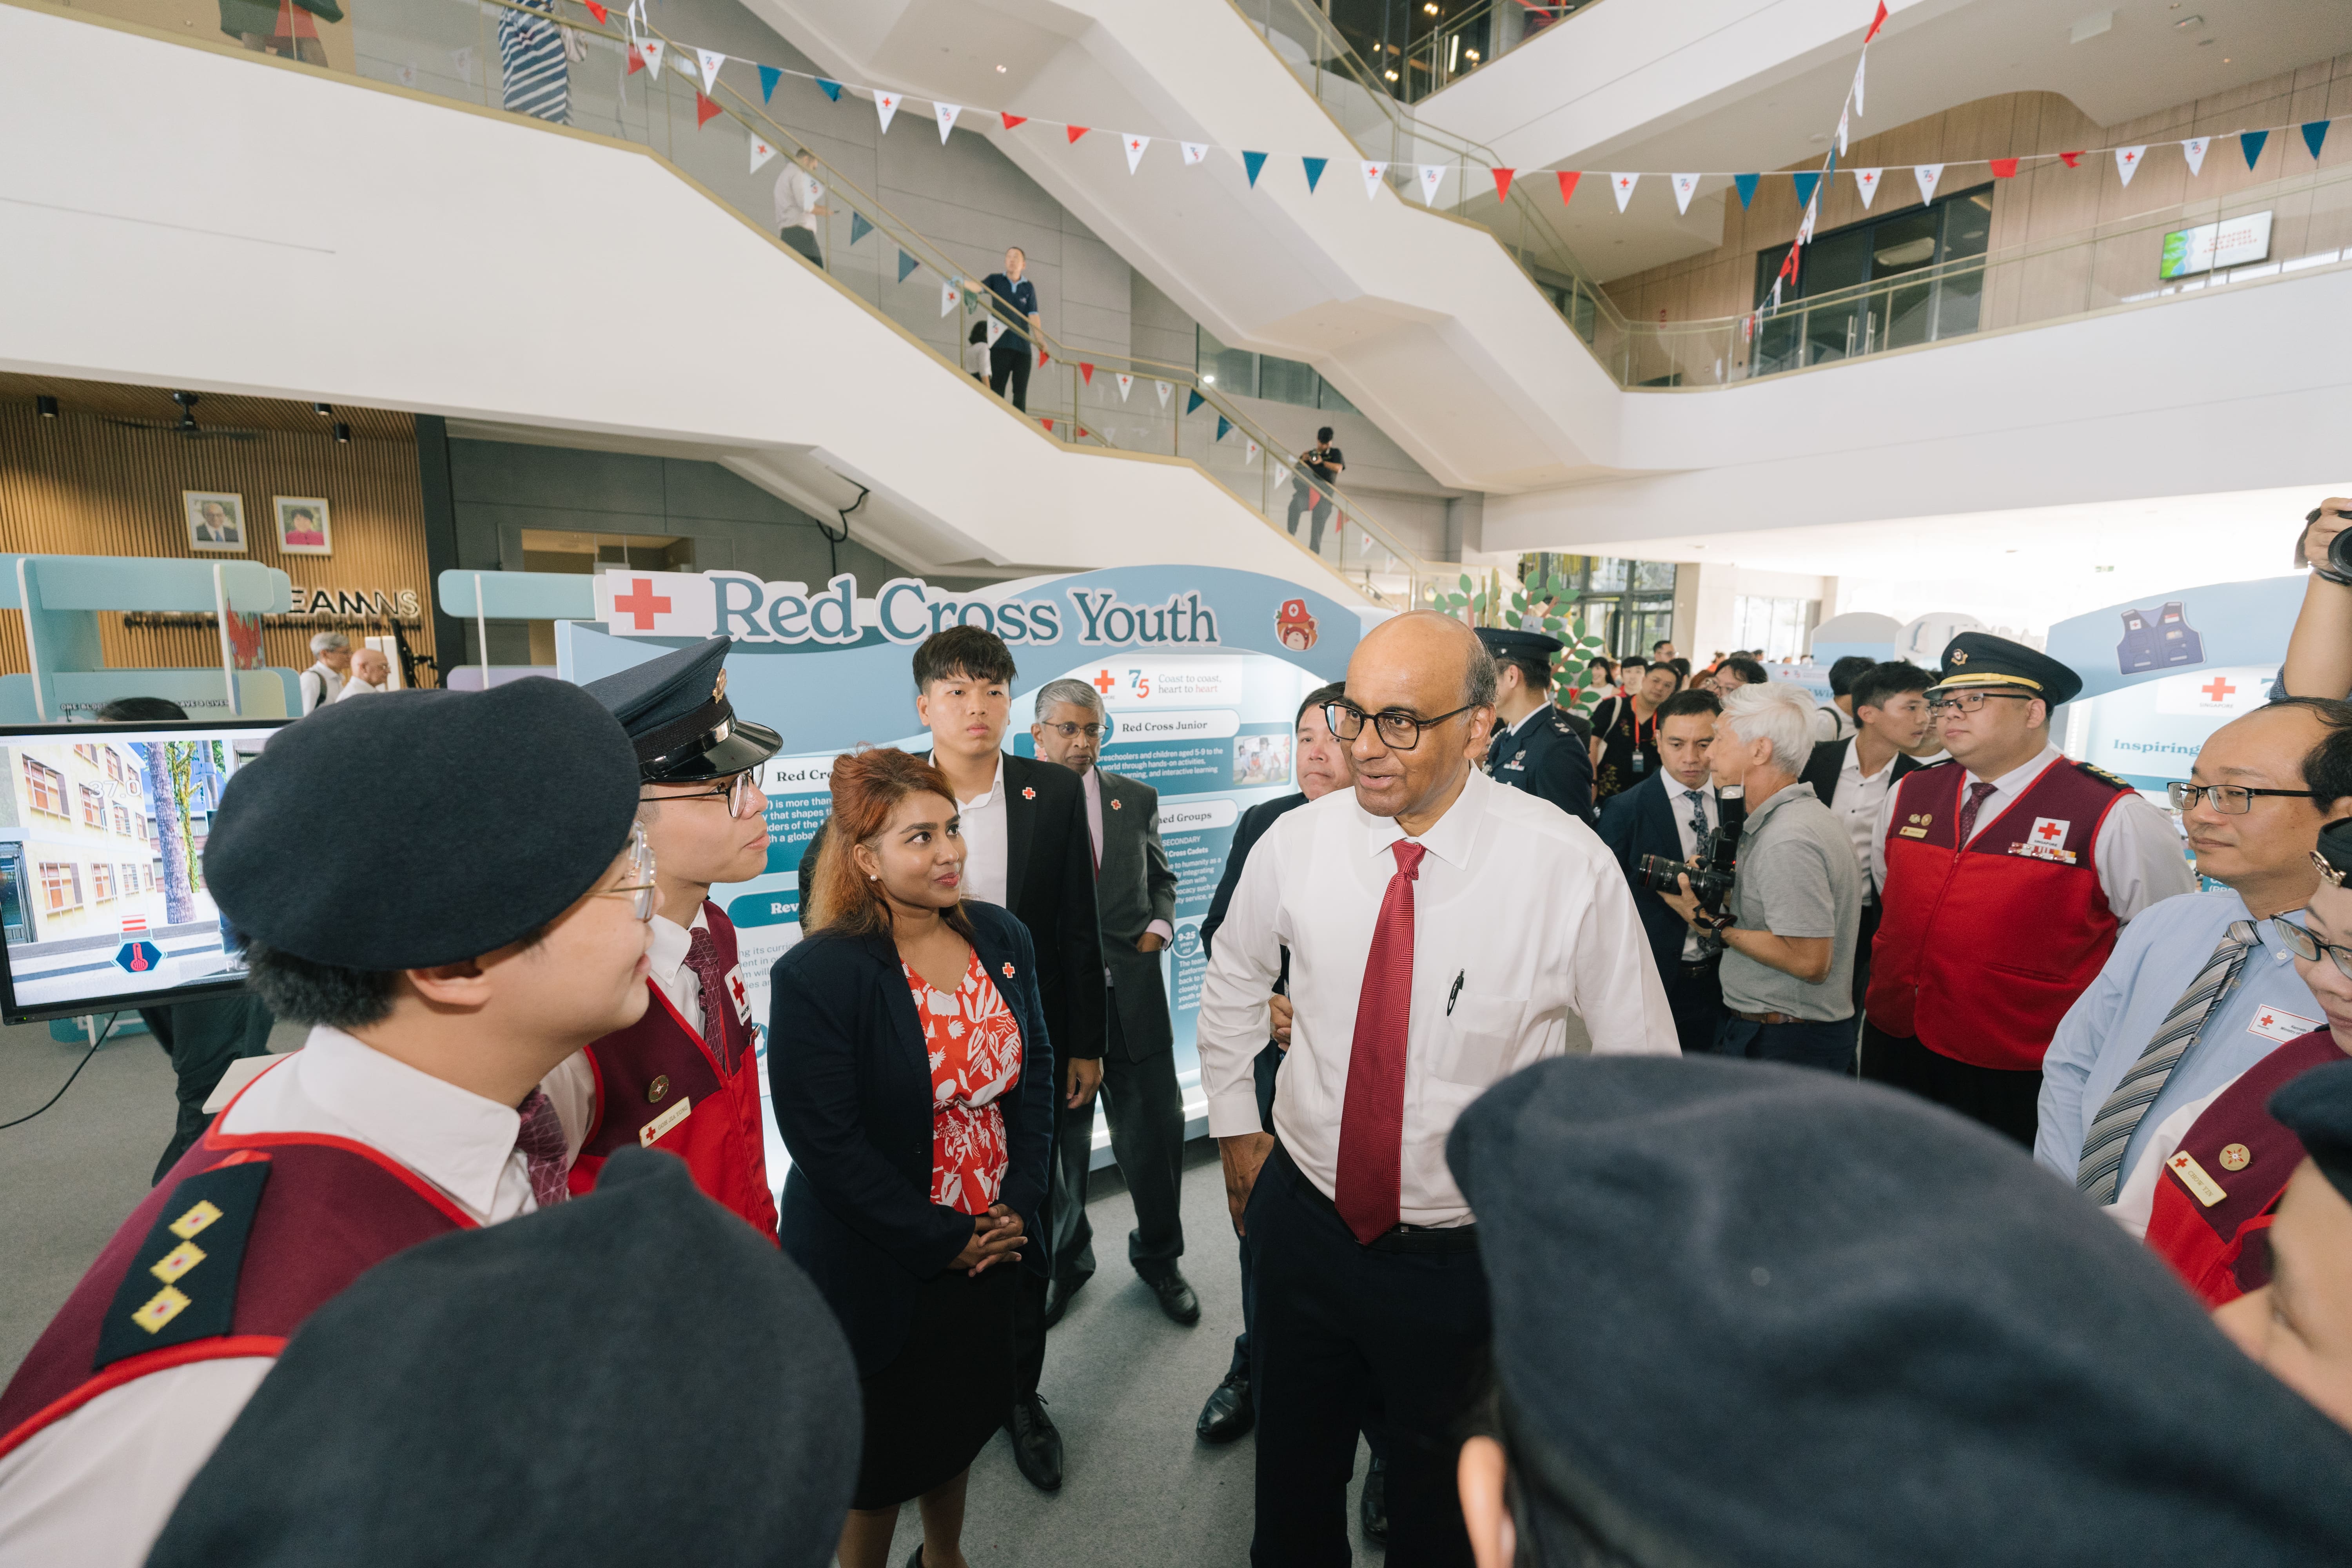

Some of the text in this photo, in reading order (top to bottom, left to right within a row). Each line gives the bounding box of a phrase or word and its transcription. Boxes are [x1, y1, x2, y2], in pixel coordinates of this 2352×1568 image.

[942, 107, 951, 121] 75
[1427, 170, 1436, 182] 75
[1924, 170, 1933, 182] 75
[1681, 178, 1690, 191] 75
[710, 577, 1217, 642] Red Cross Youth
[1129, 670, 1149, 698] 75
[1158, 674, 1221, 683] Coast to coast,
[1158, 684, 1182, 693] heart
[1195, 684, 1218, 693] heart
[1122, 720, 1207, 732] Red Cross Junior
[1178, 749, 1194, 758] aged
[2113, 739, 2201, 757] Inspiring
[1102, 762, 1121, 771] world
[1122, 761, 1147, 770] through
[1148, 760, 1177, 768] hands-on
[777, 770, 806, 782] Red
[1149, 769, 1161, 777] and
[1161, 768, 1193, 776] interactive
[89, 779, 141, 799] 37.0
[775, 800, 783, 808] is
[786, 799, 809, 808] more
[811, 797, 832, 806] than
[791, 809, 824, 819] shapes
[1177, 813, 1212, 822] Groups
[767, 823, 789, 832] ders
[791, 821, 801, 830] of
[788, 831, 815, 843] global
[1162, 836, 1201, 847] SECONDARY
[1182, 859, 1209, 867] humanity
[1183, 867, 1214, 877] integrating
[1197, 884, 1211, 892] such
[771, 902, 799, 915] Rev
[1178, 931, 1196, 940] 9-25
[740, 959, 757, 967] ent
[754, 967, 769, 977] will
[1179, 966, 1206, 977] platforms
[1179, 976, 1193, 985] back
[1178, 984, 1199, 993] closely
[1178, 993, 1195, 1004] youth
[658, 1120, 668, 1130] GOH
[2188, 1171, 2214, 1197] CHOW YIN
